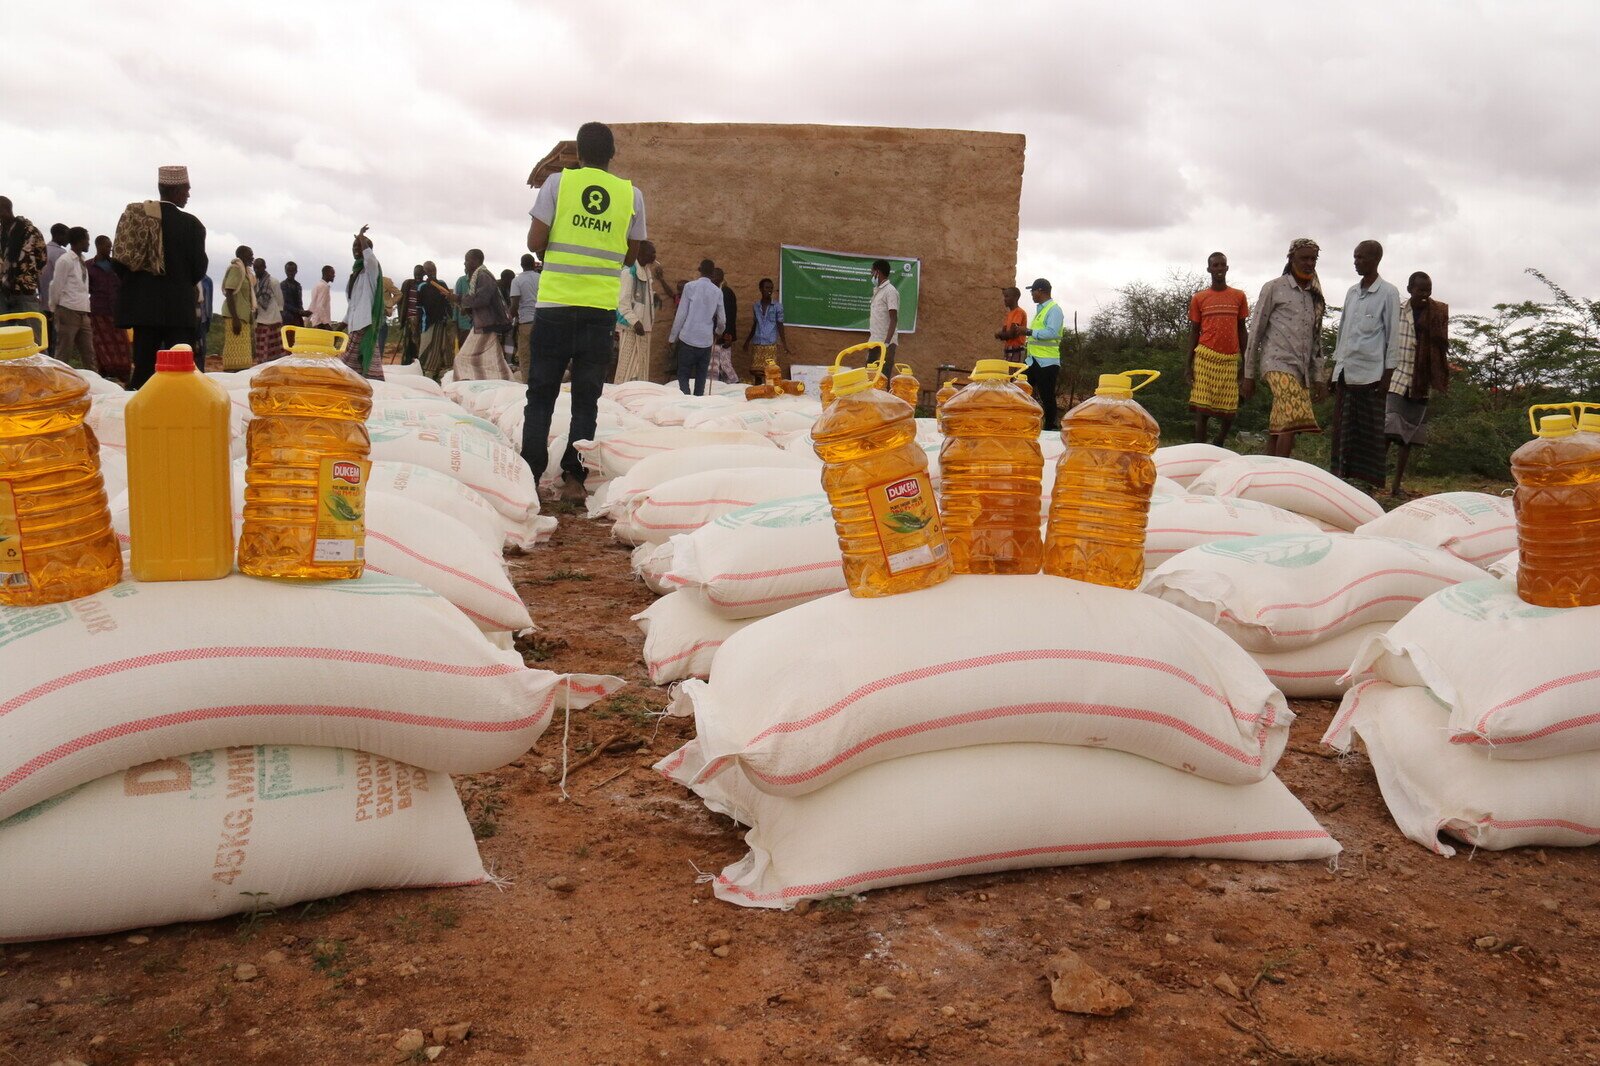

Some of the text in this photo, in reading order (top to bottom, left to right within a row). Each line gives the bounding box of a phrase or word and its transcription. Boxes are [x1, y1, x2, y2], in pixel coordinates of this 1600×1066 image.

[572, 214, 612, 233] OXFAM
[334, 465, 360, 477] DUKEM
[888, 479, 918, 498] DUKEM
